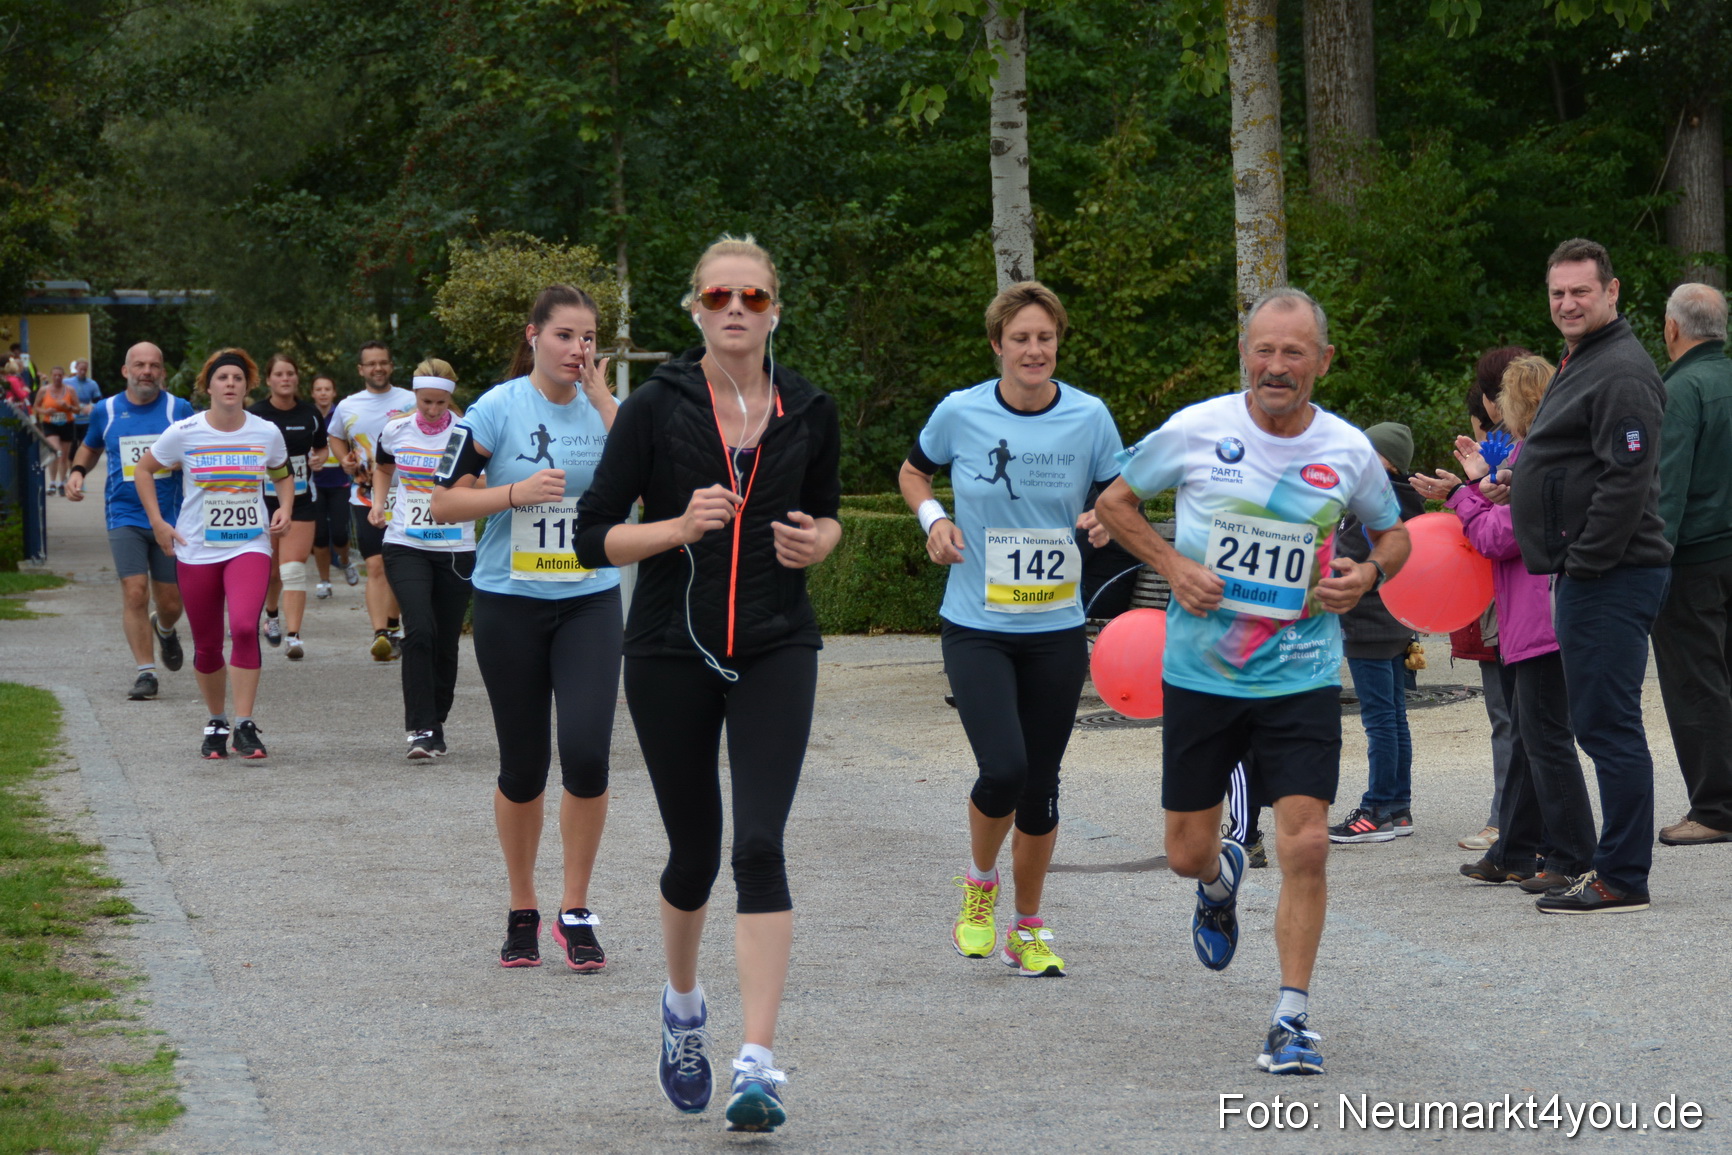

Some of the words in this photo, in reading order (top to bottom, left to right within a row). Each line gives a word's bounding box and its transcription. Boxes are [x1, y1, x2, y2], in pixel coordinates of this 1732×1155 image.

[561, 435, 591, 446] GYM
[225, 454, 240, 465] BEI
[242, 454, 258, 466] MIR
[562, 458, 600, 467] Halbmara
[1022, 452, 1053, 466] GYM
[1057, 454, 1075, 466] HIP
[1029, 470, 1066, 479] P-Seminar
[1211, 466, 1244, 479] PARTL
[1020, 478, 1074, 489] Halbmarathon
[1210, 475, 1243, 485] Neumarkt
[514, 505, 546, 514] PARTL
[548, 506, 579, 514] Neuma
[210, 506, 258, 527] 2299
[220, 531, 249, 540] Marina
[1214, 518, 1249, 534] PARTL
[1251, 527, 1301, 543] Neumarkt
[988, 536, 1020, 544] PARTL
[1022, 536, 1067, 546] Neumarkt
[536, 557, 581, 570] Antonia
[1007, 549, 1065, 581] 142
[1216, 536, 1306, 583] 2410
[1013, 589, 1055, 602] Sandra
[1231, 583, 1278, 604] Rudolf
